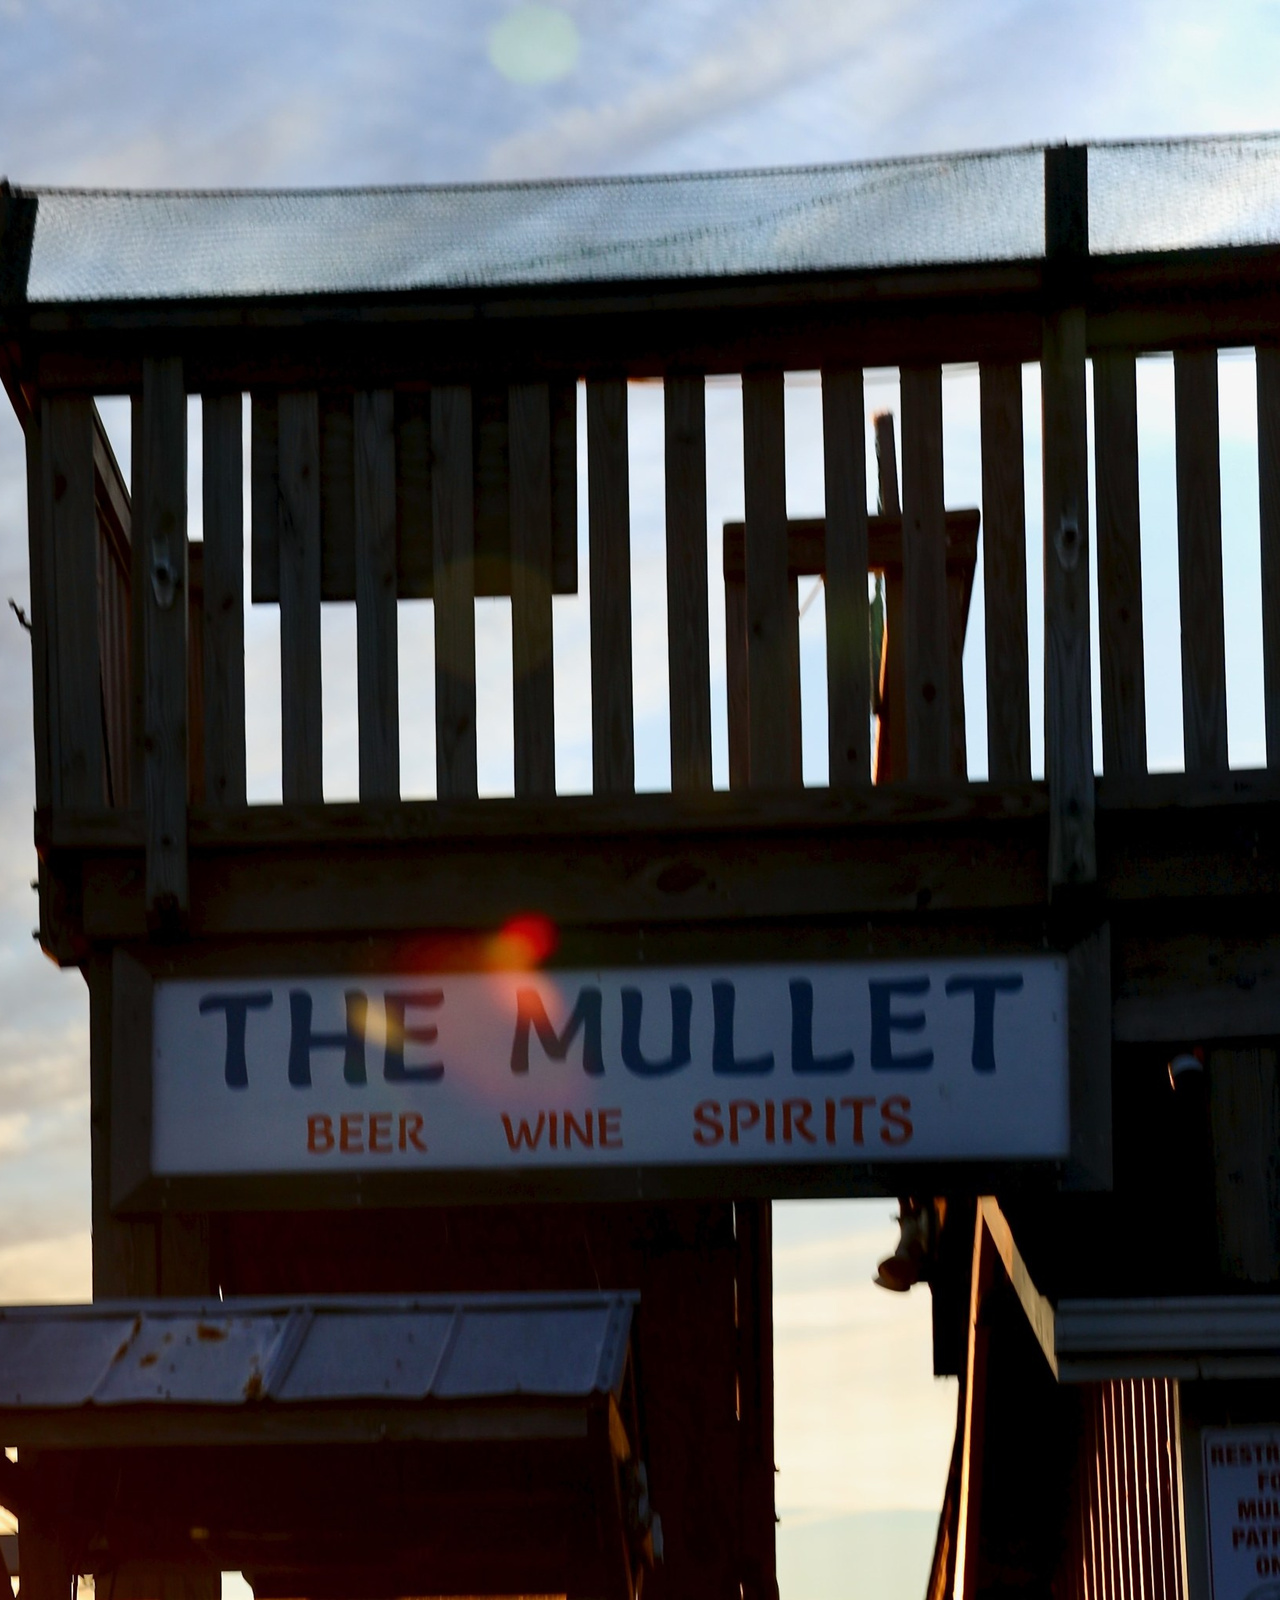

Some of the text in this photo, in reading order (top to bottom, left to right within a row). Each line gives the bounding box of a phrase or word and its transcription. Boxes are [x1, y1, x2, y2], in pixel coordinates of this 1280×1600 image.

[200, 973, 1024, 1089] THE MULLET
[306, 1096, 915, 1154] BEER WINE SPIRITS
